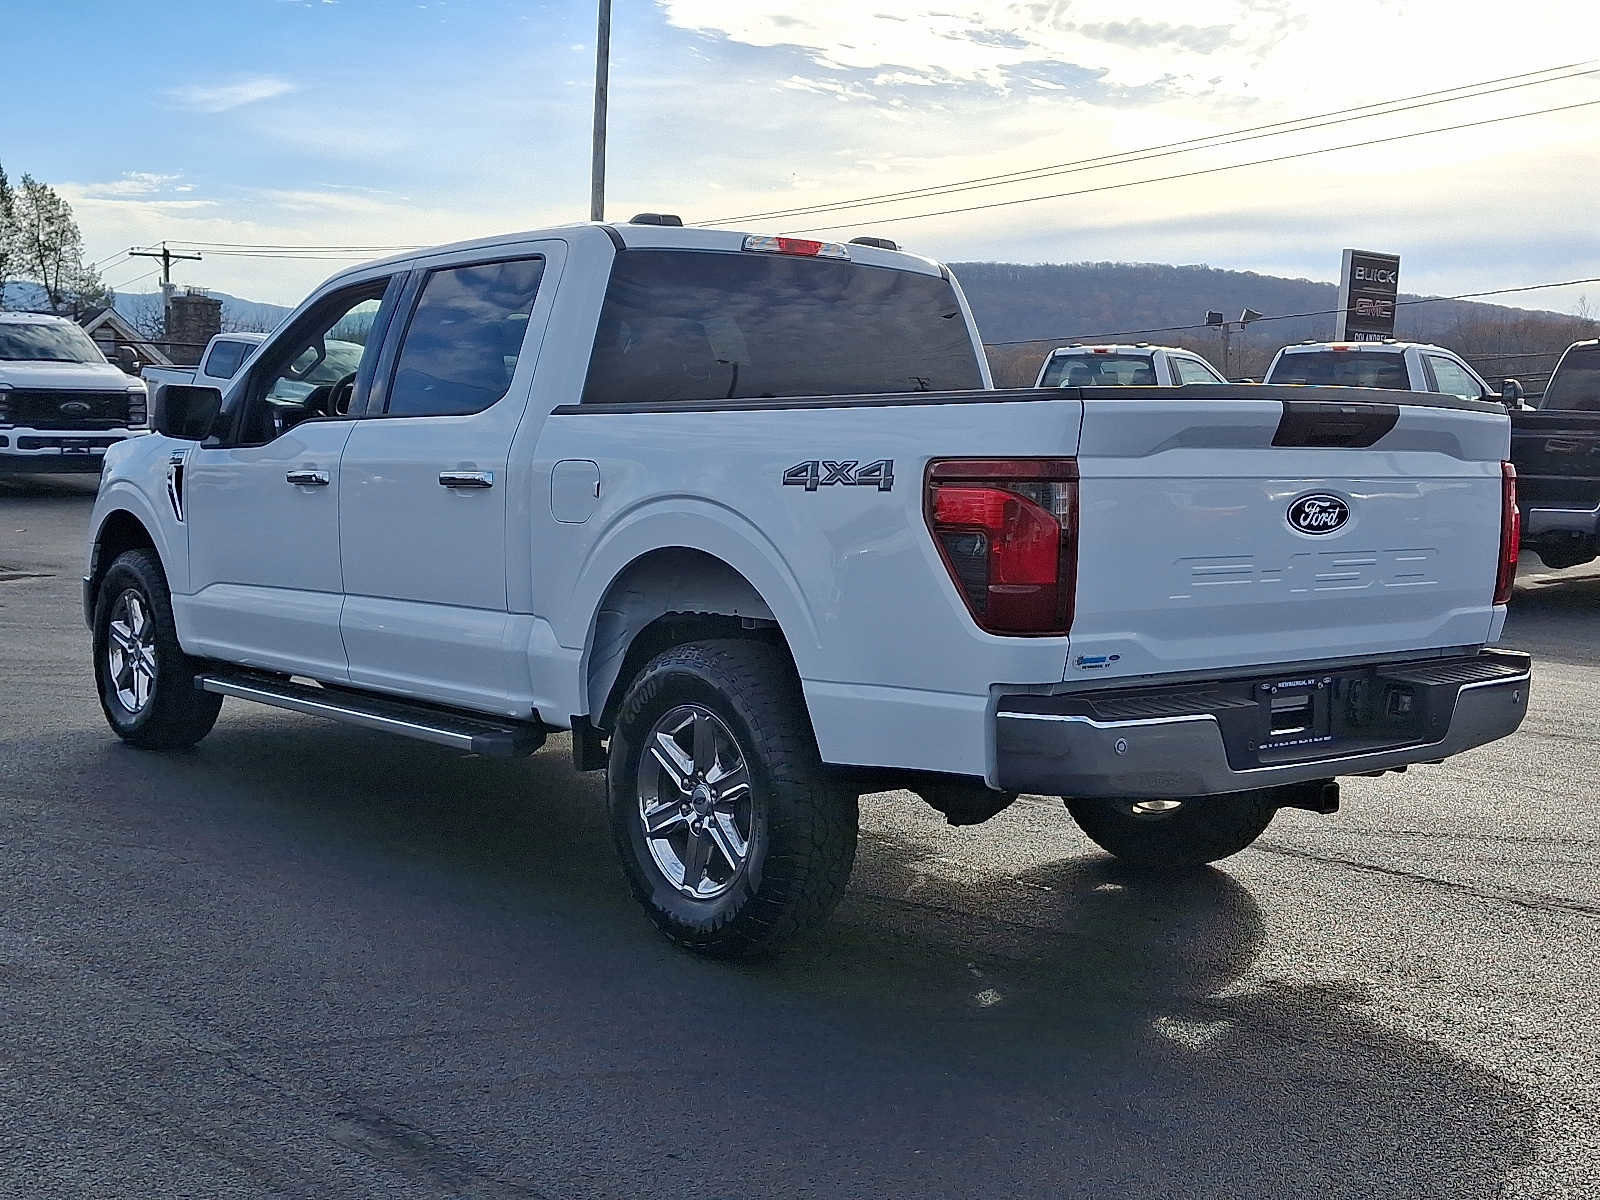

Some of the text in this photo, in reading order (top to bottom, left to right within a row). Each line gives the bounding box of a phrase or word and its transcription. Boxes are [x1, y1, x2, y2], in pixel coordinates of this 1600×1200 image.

[1355, 266, 1397, 283] BUICK
[1355, 298, 1393, 318] GMC
[1354, 332, 1388, 342] COLANDRE
[783, 459, 894, 491] 4X4
[1300, 500, 1339, 527] Ford
[1169, 547, 1440, 600] F-150
